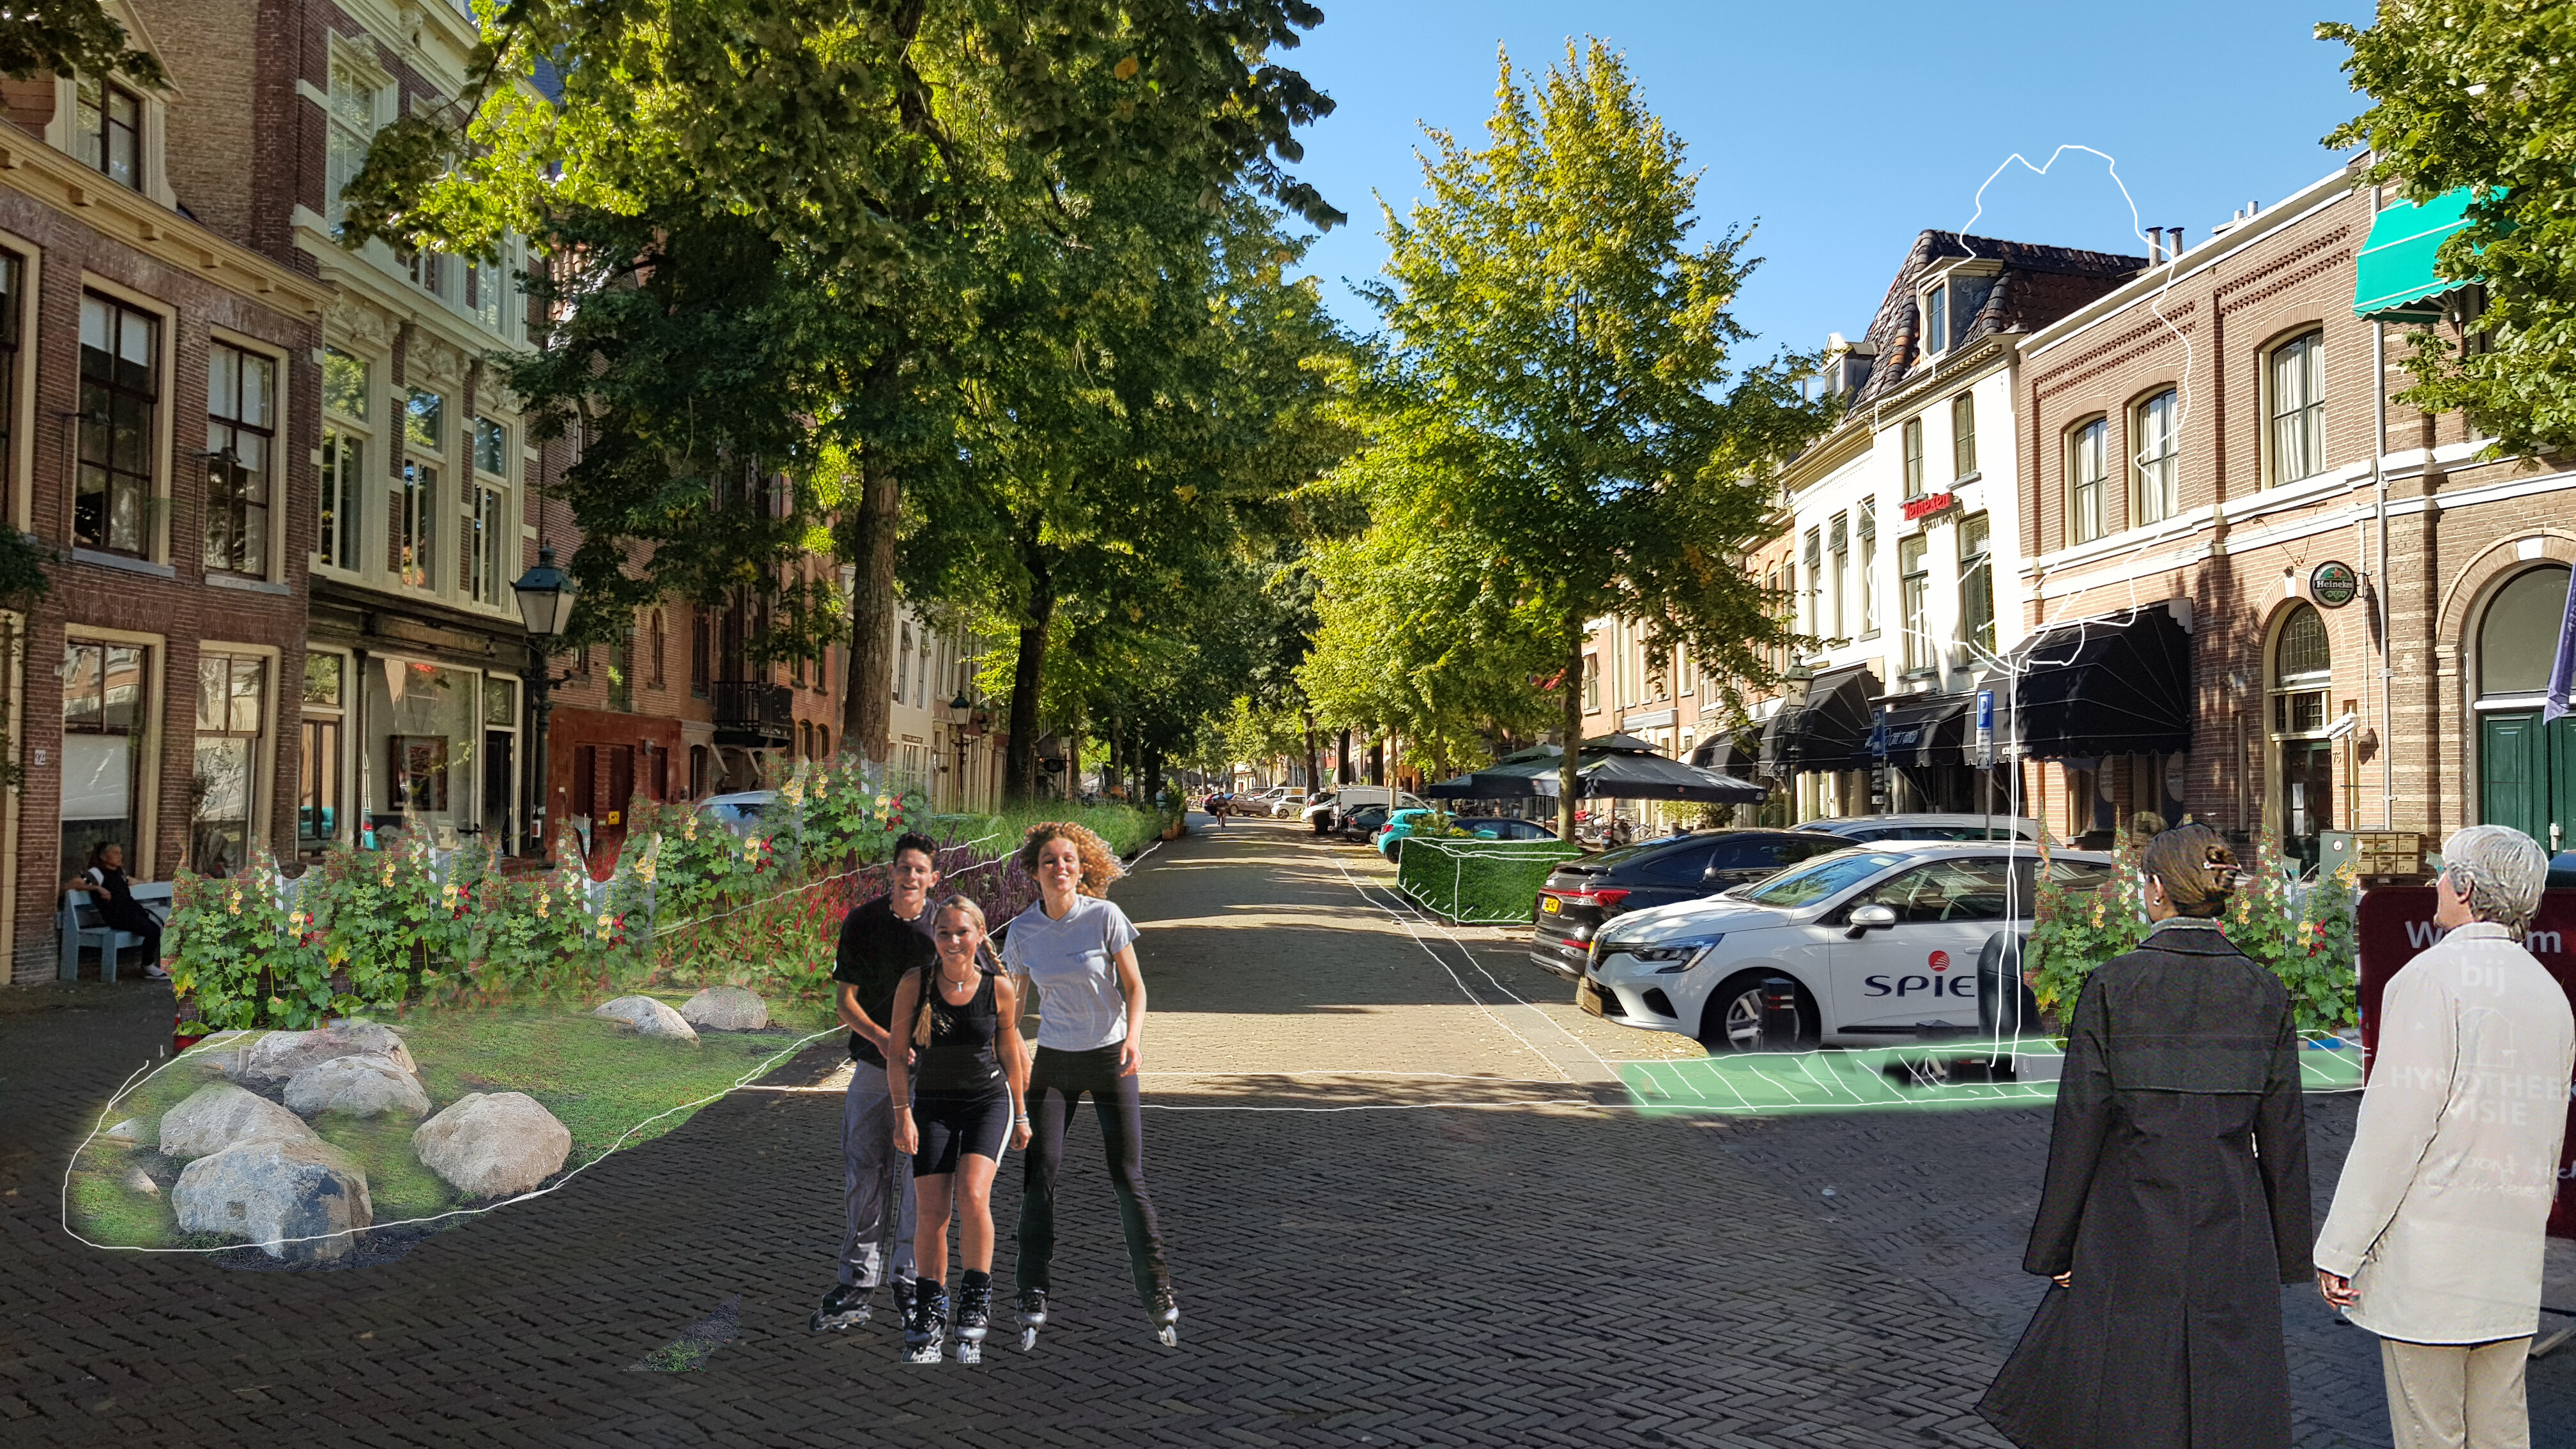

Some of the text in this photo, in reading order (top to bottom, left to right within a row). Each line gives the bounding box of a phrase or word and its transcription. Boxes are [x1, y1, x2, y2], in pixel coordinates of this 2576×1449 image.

[1979, 696, 1989, 726] P
[2333, 751, 2342, 763] 75
[1864, 975, 1975, 998] SPIE
[2461, 956, 2505, 997] bij
